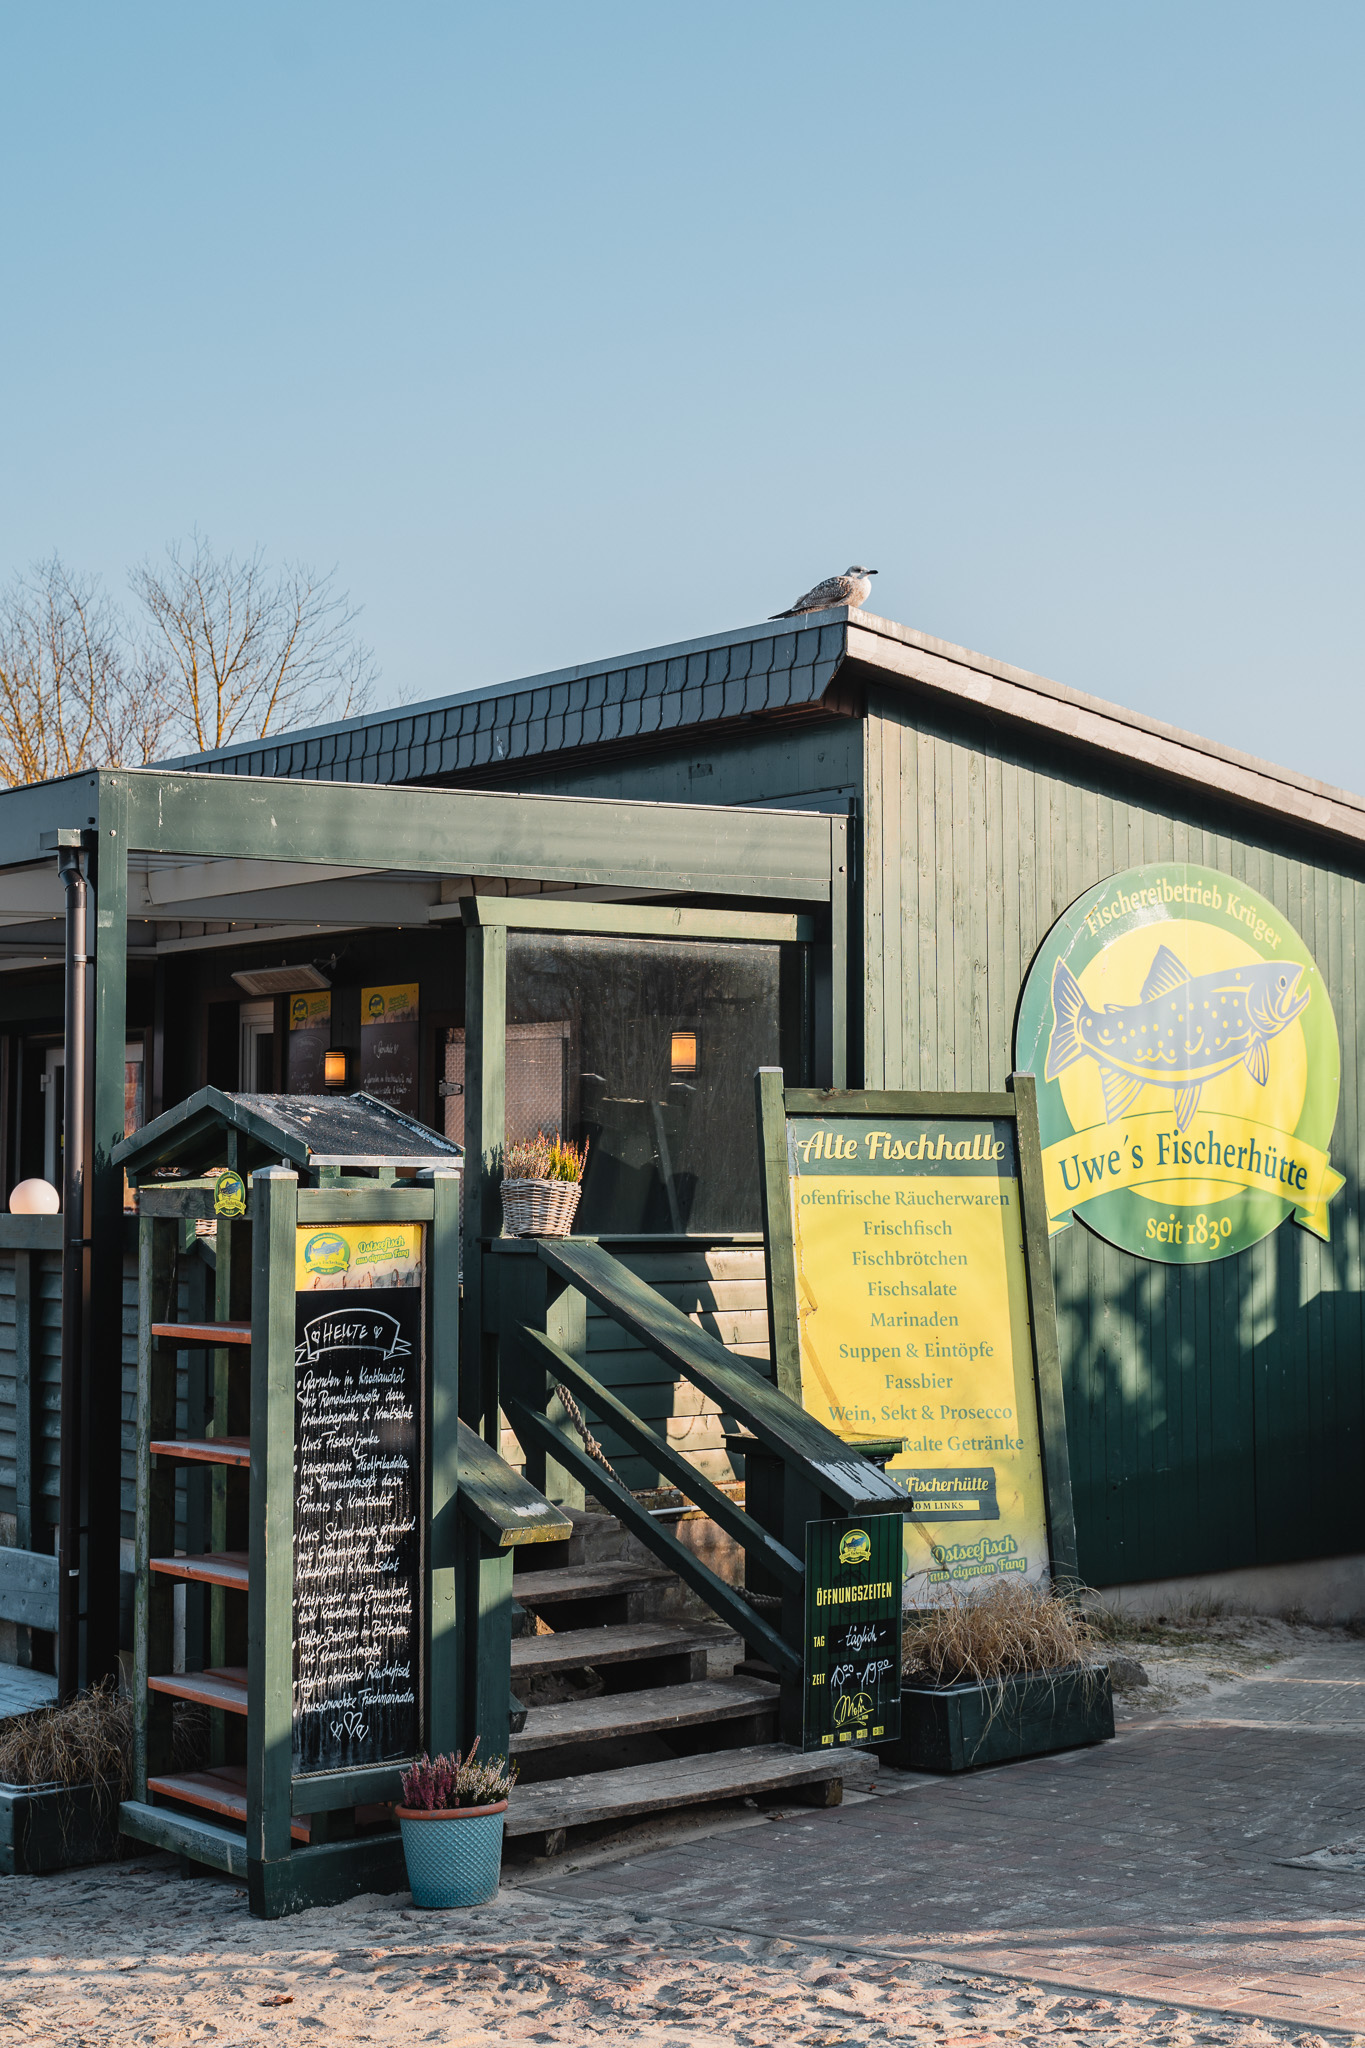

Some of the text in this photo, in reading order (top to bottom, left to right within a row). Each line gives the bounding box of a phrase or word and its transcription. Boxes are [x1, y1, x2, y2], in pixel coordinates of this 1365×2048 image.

[1084, 877, 1282, 950] Fischereibetrieb Krüger
[798, 1131, 1005, 1163] Alte Fischhalle
[1156, 1129, 1308, 1191] Fischerhütte
[801, 1190, 1010, 1206] ofenfrische Räucherwaren
[864, 1220, 952, 1235] Frischfisch
[1146, 1214, 1232, 1250] seit 1830
[357, 1235, 405, 1254] Ostseefisch
[355, 1257, 368, 1265] aus
[369, 1253, 393, 1265] eigenem
[394, 1248, 409, 1259] Fang
[852, 1250, 967, 1266] Fischbrötchen
[868, 1281, 957, 1296] Fischsalate
[870, 1311, 959, 1327] Marinaden
[323, 1323, 368, 1342] HEUTE
[839, 1341, 994, 1362] Suppen & Eintöpfe
[885, 1373, 953, 1389] Fassbier
[828, 1405, 1012, 1424] Wein, Sekt & Prosecco
[903, 1434, 1025, 1452] kalte Getränke
[906, 1476, 989, 1492] Fischerhütte
[297, 1495, 331, 1513] Pommes
[347, 1490, 394, 1508] Krautsalat
[923, 1502, 932, 1510] M
[935, 1502, 964, 1510] LINKS
[931, 1535, 1018, 1564] Ostseefisch
[929, 1557, 1026, 1583] aus eigenem Fang
[816, 1582, 892, 1607] ÖFFNUNGSZEITEN
[813, 1624, 877, 1651] TAG täglich
[812, 1673, 826, 1686] ZEIT
